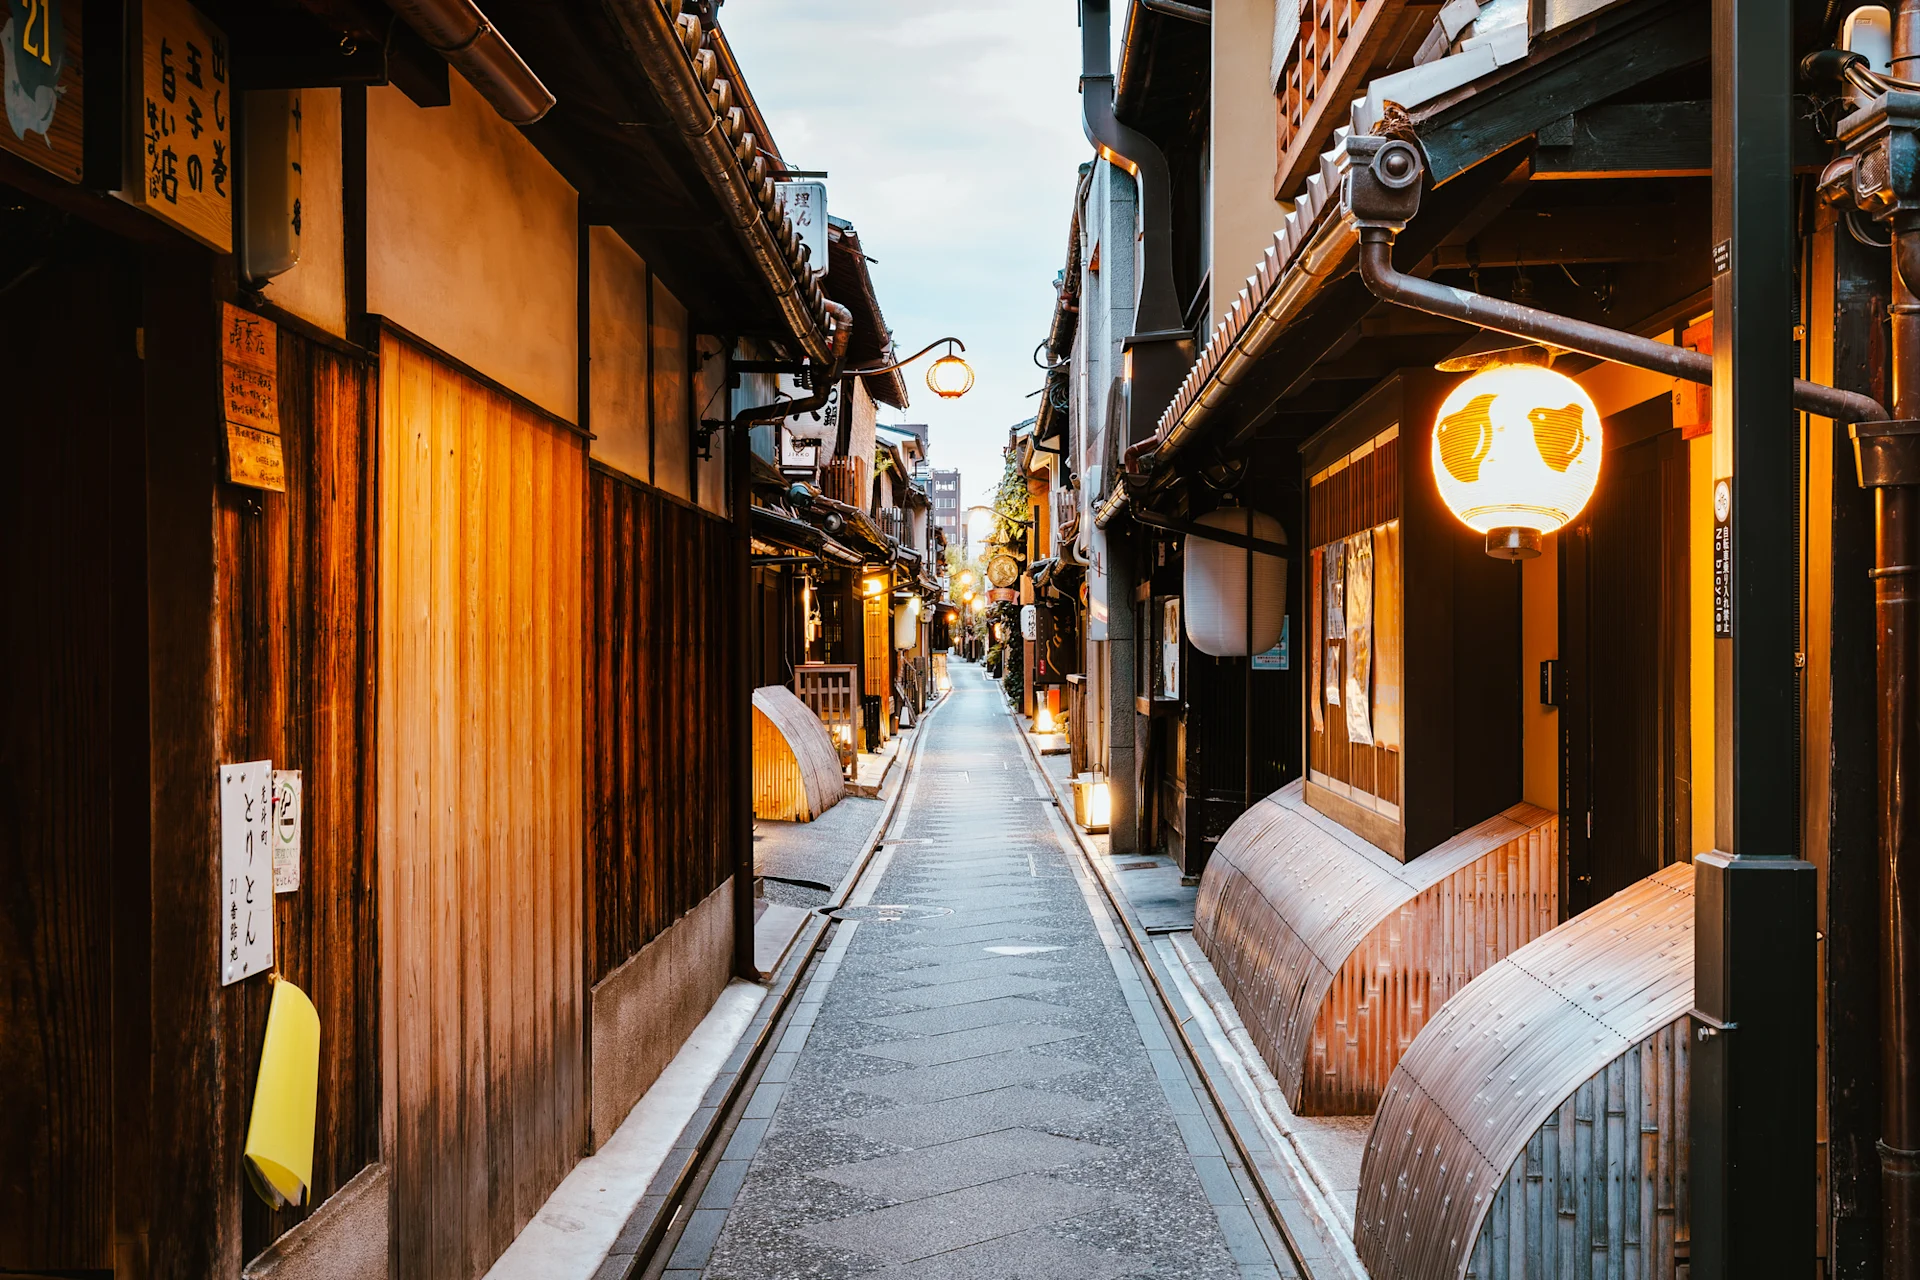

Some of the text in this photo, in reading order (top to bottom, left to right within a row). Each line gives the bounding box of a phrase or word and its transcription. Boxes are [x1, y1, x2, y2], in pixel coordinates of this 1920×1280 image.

[22, 0, 52, 67] 21
[160, 37, 179, 205] 旨い店
[185, 41, 204, 193] 玉子の
[211, 35, 228, 199] 出し巻
[229, 321, 265, 356] 喫茶店
[1715, 528, 1723, 633] No bicycles
[1722, 525, 1730, 633] 自転車乗り入れ禁止
[244, 792, 257, 947] とりとん
